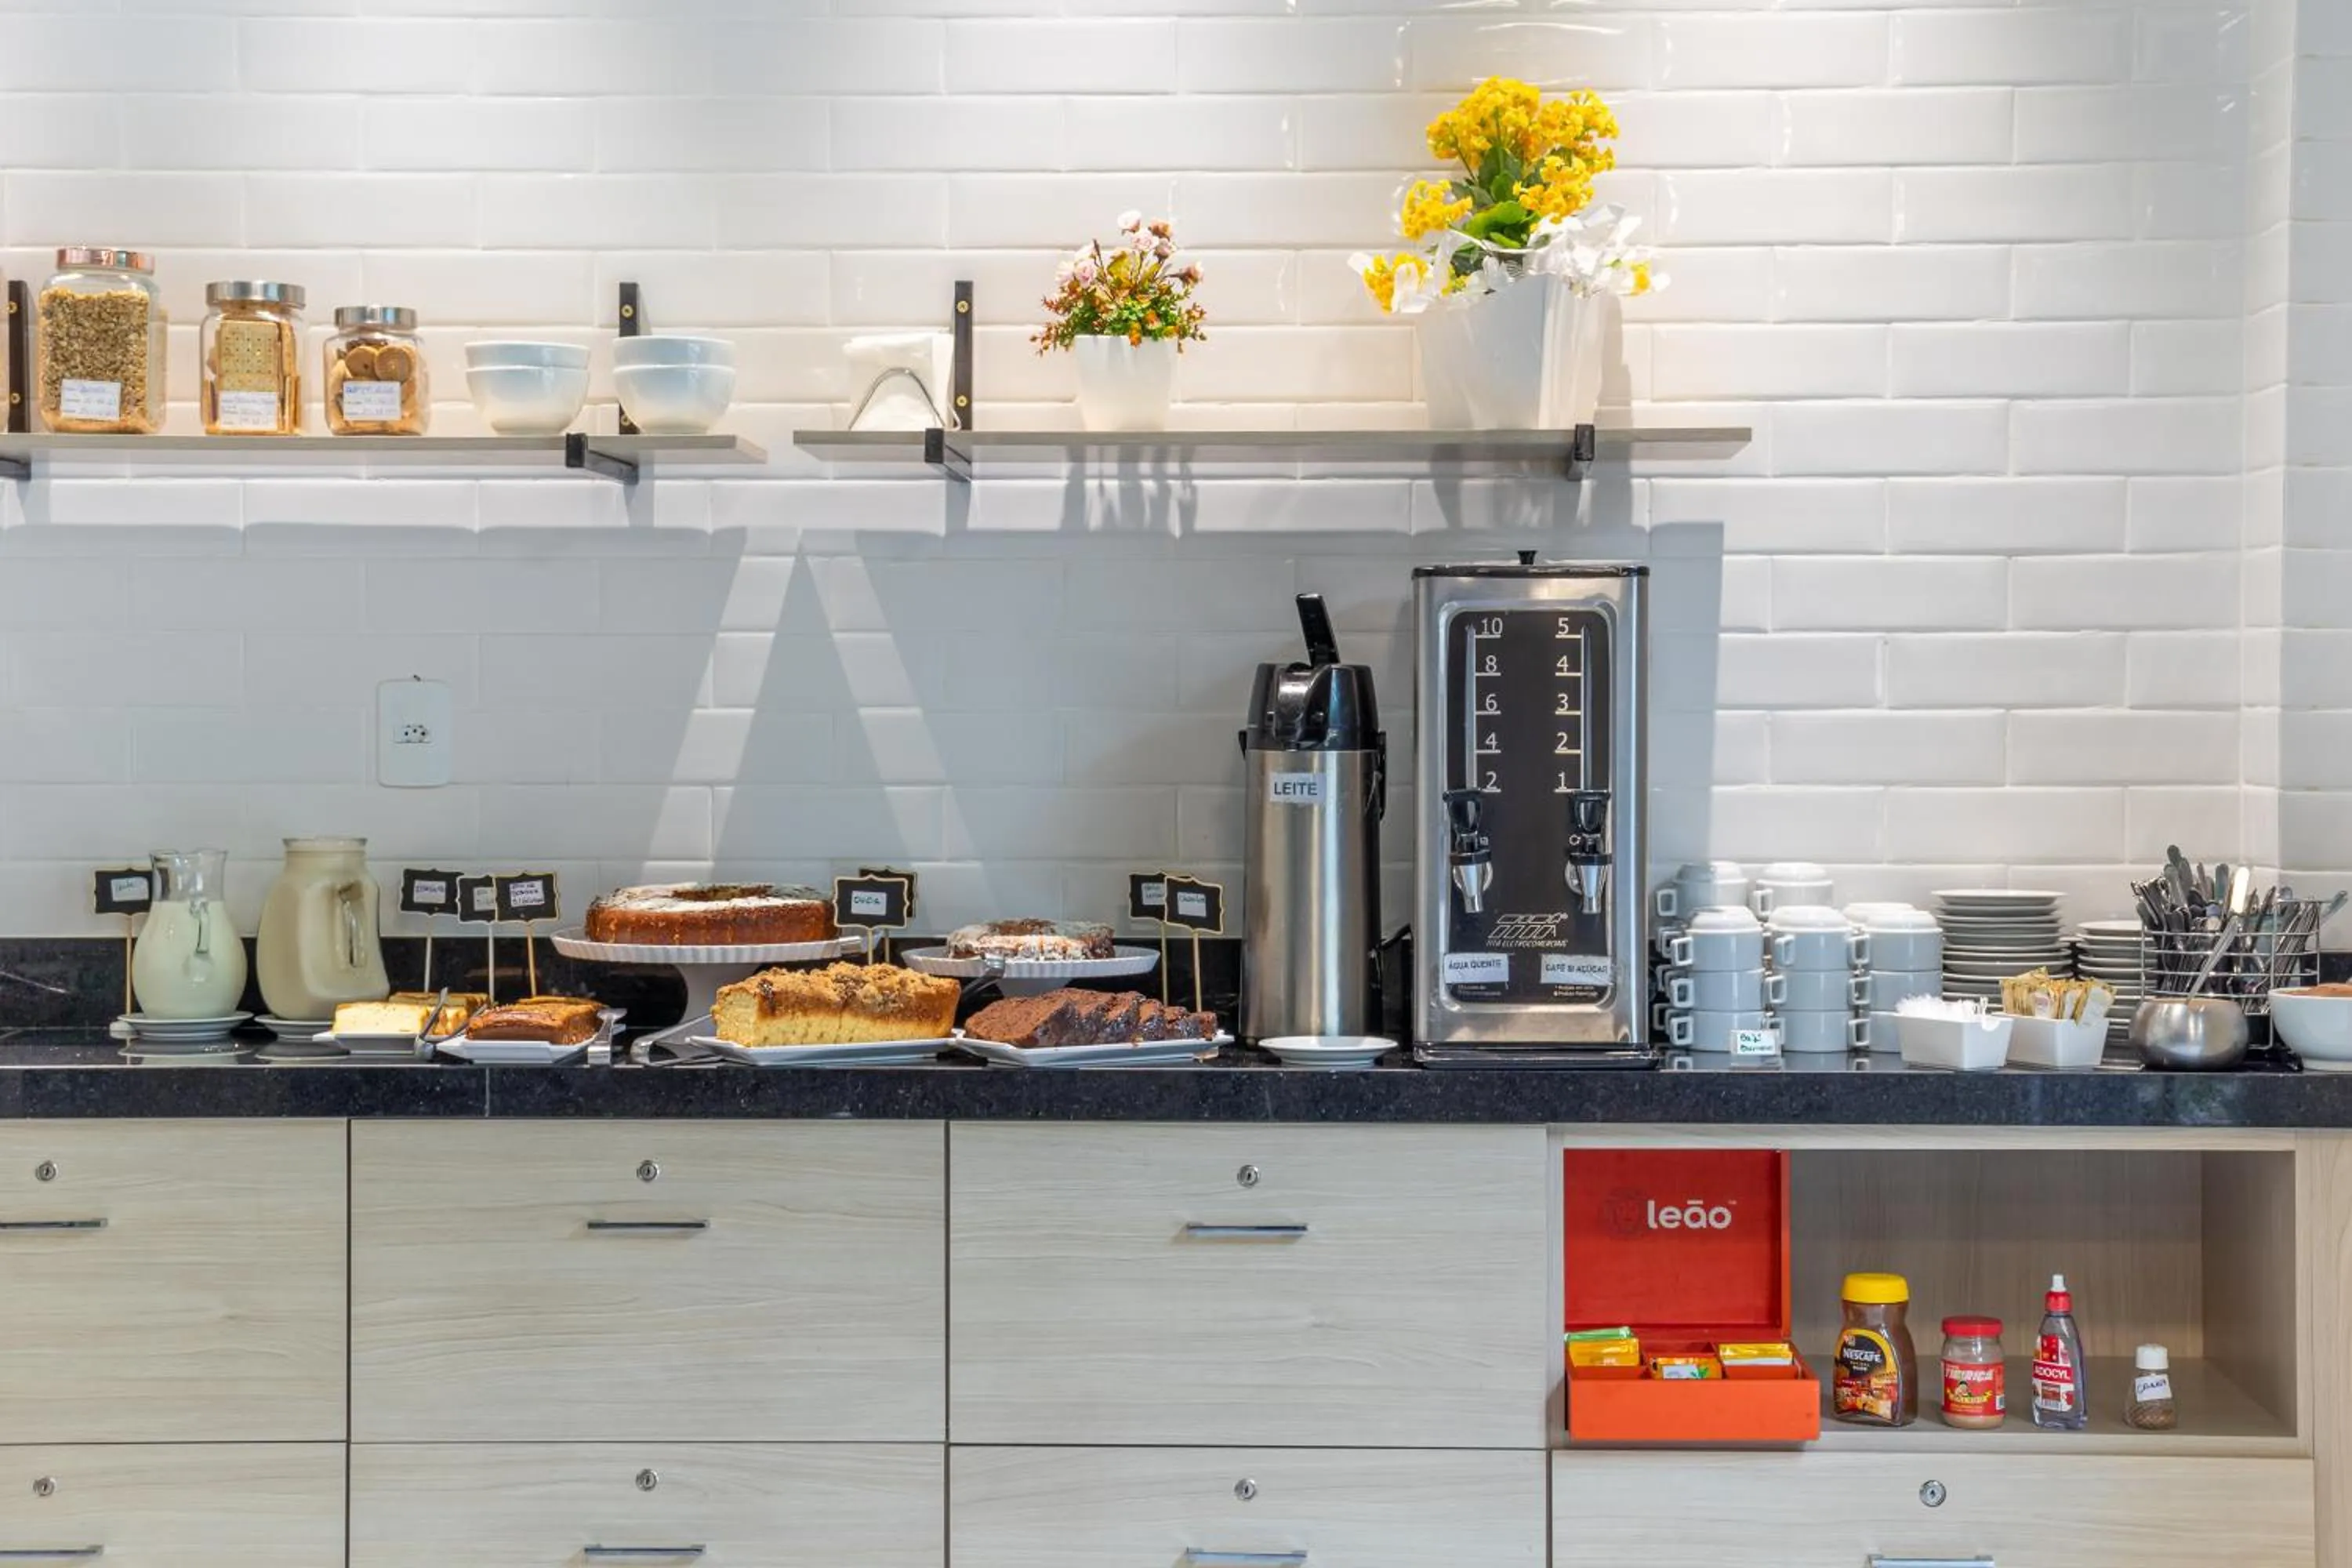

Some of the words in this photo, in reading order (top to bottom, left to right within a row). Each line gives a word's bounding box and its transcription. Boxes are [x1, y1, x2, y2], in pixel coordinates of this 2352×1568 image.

[1481, 618, 1503, 634] 10
[1557, 618, 1569, 634] 5
[1485, 655, 1497, 673] 8
[1556, 655, 1569, 673] 4
[1485, 694, 1497, 712] 6
[1557, 694, 1569, 712] 3
[1485, 732, 1497, 750] 4
[1556, 731, 1568, 750] 2
[1274, 782, 1318, 796] LEITE
[1486, 771, 1497, 789] 2
[1558, 771, 1568, 790] 1
[1471, 959, 1502, 969] QUENTE
[1843, 1348, 1882, 1363] NESCAFÉ
